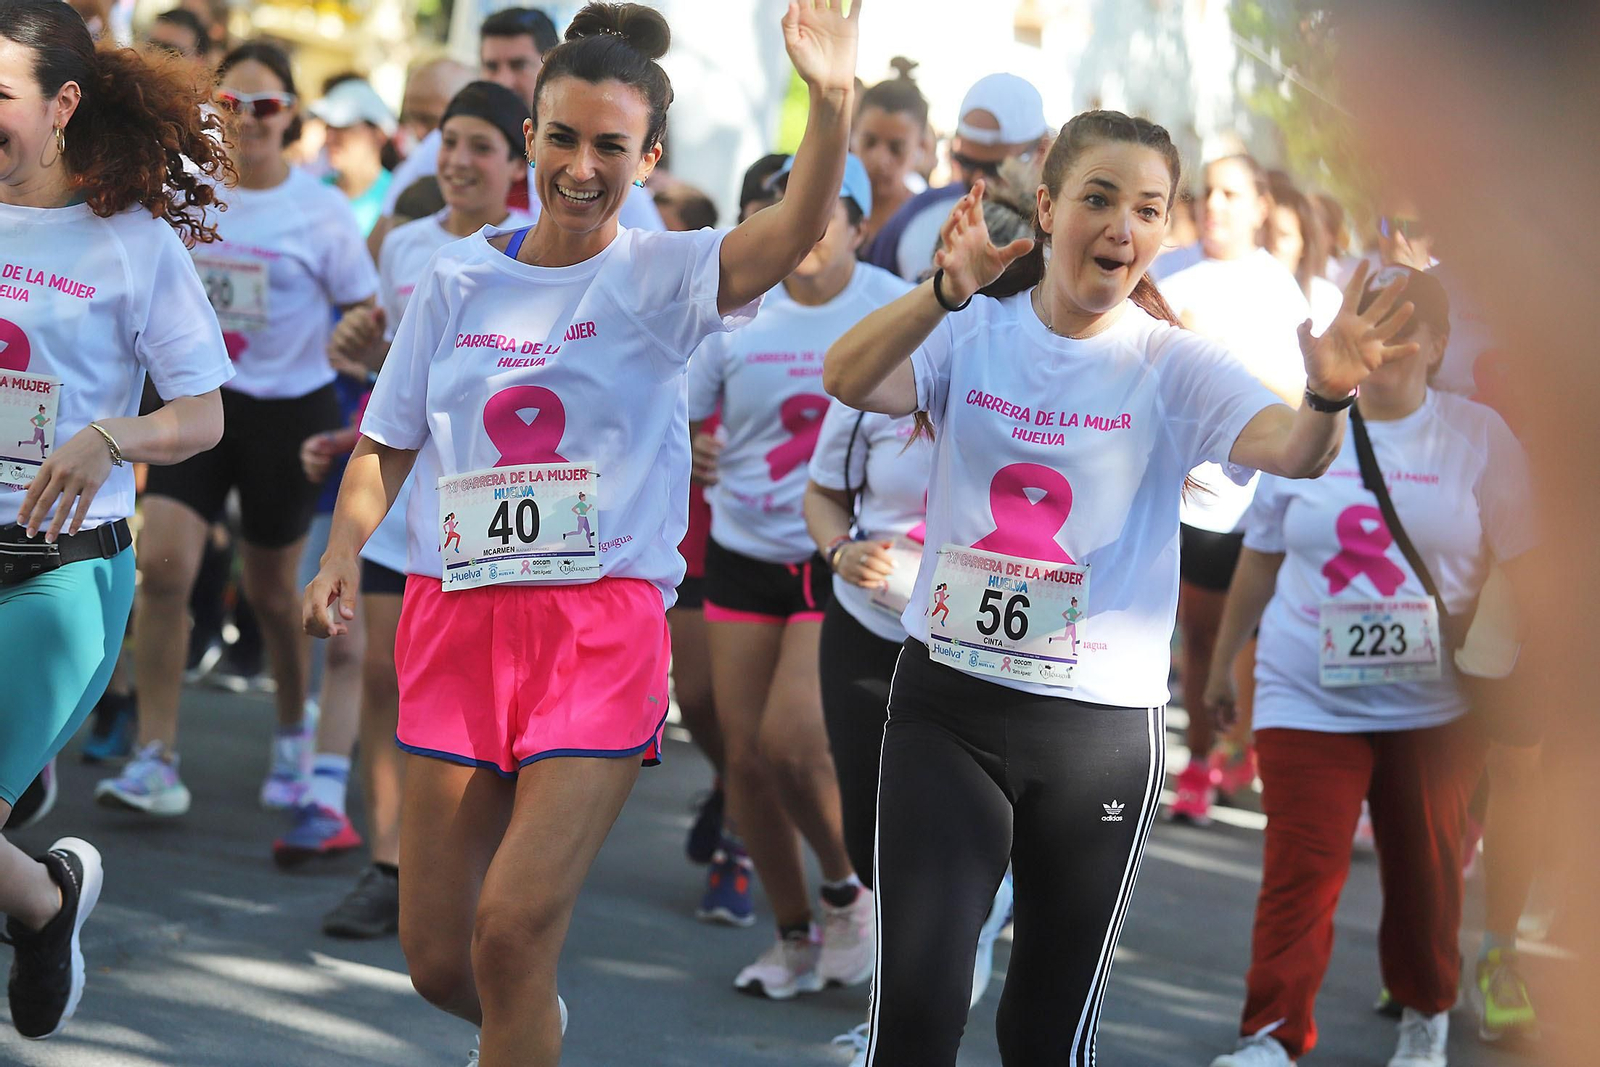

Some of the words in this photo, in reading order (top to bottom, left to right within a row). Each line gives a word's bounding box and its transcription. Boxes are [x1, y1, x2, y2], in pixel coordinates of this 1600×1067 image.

[2, 263, 24, 281] DE
[25, 268, 44, 286] LA
[48, 273, 96, 299] MUJER
[563, 321, 597, 342] UJER
[455, 333, 516, 353] CARRERA
[520, 340, 543, 355] DE
[497, 357, 546, 368] HUELVA
[11, 377, 51, 394] MUJER
[966, 389, 1030, 423] CARRERA
[1034, 410, 1056, 426] DE
[1059, 411, 1079, 427] LA
[1083, 413, 1132, 432] MUJER
[1011, 427, 1065, 446] HUELVA
[461, 473, 506, 492] CARRERA
[509, 471, 526, 485] DE
[528, 469, 544, 482] LA
[547, 468, 588, 482] MUJER
[494, 485, 535, 500] HUELVA
[488, 498, 540, 545] 40
[483, 546, 515, 556] MCARMEN
[449, 568, 482, 584] Huelva
[960, 553, 1002, 574] CARRERA
[1006, 564, 1023, 577] DE
[1024, 568, 1040, 580] LA
[1043, 569, 1084, 586] MUJER
[988, 575, 1028, 593] HUELVA
[976, 588, 1030, 641] 56
[983, 637, 1003, 647] CINTA
[1348, 623, 1408, 657] 223
[932, 643, 964, 659] Huelva
